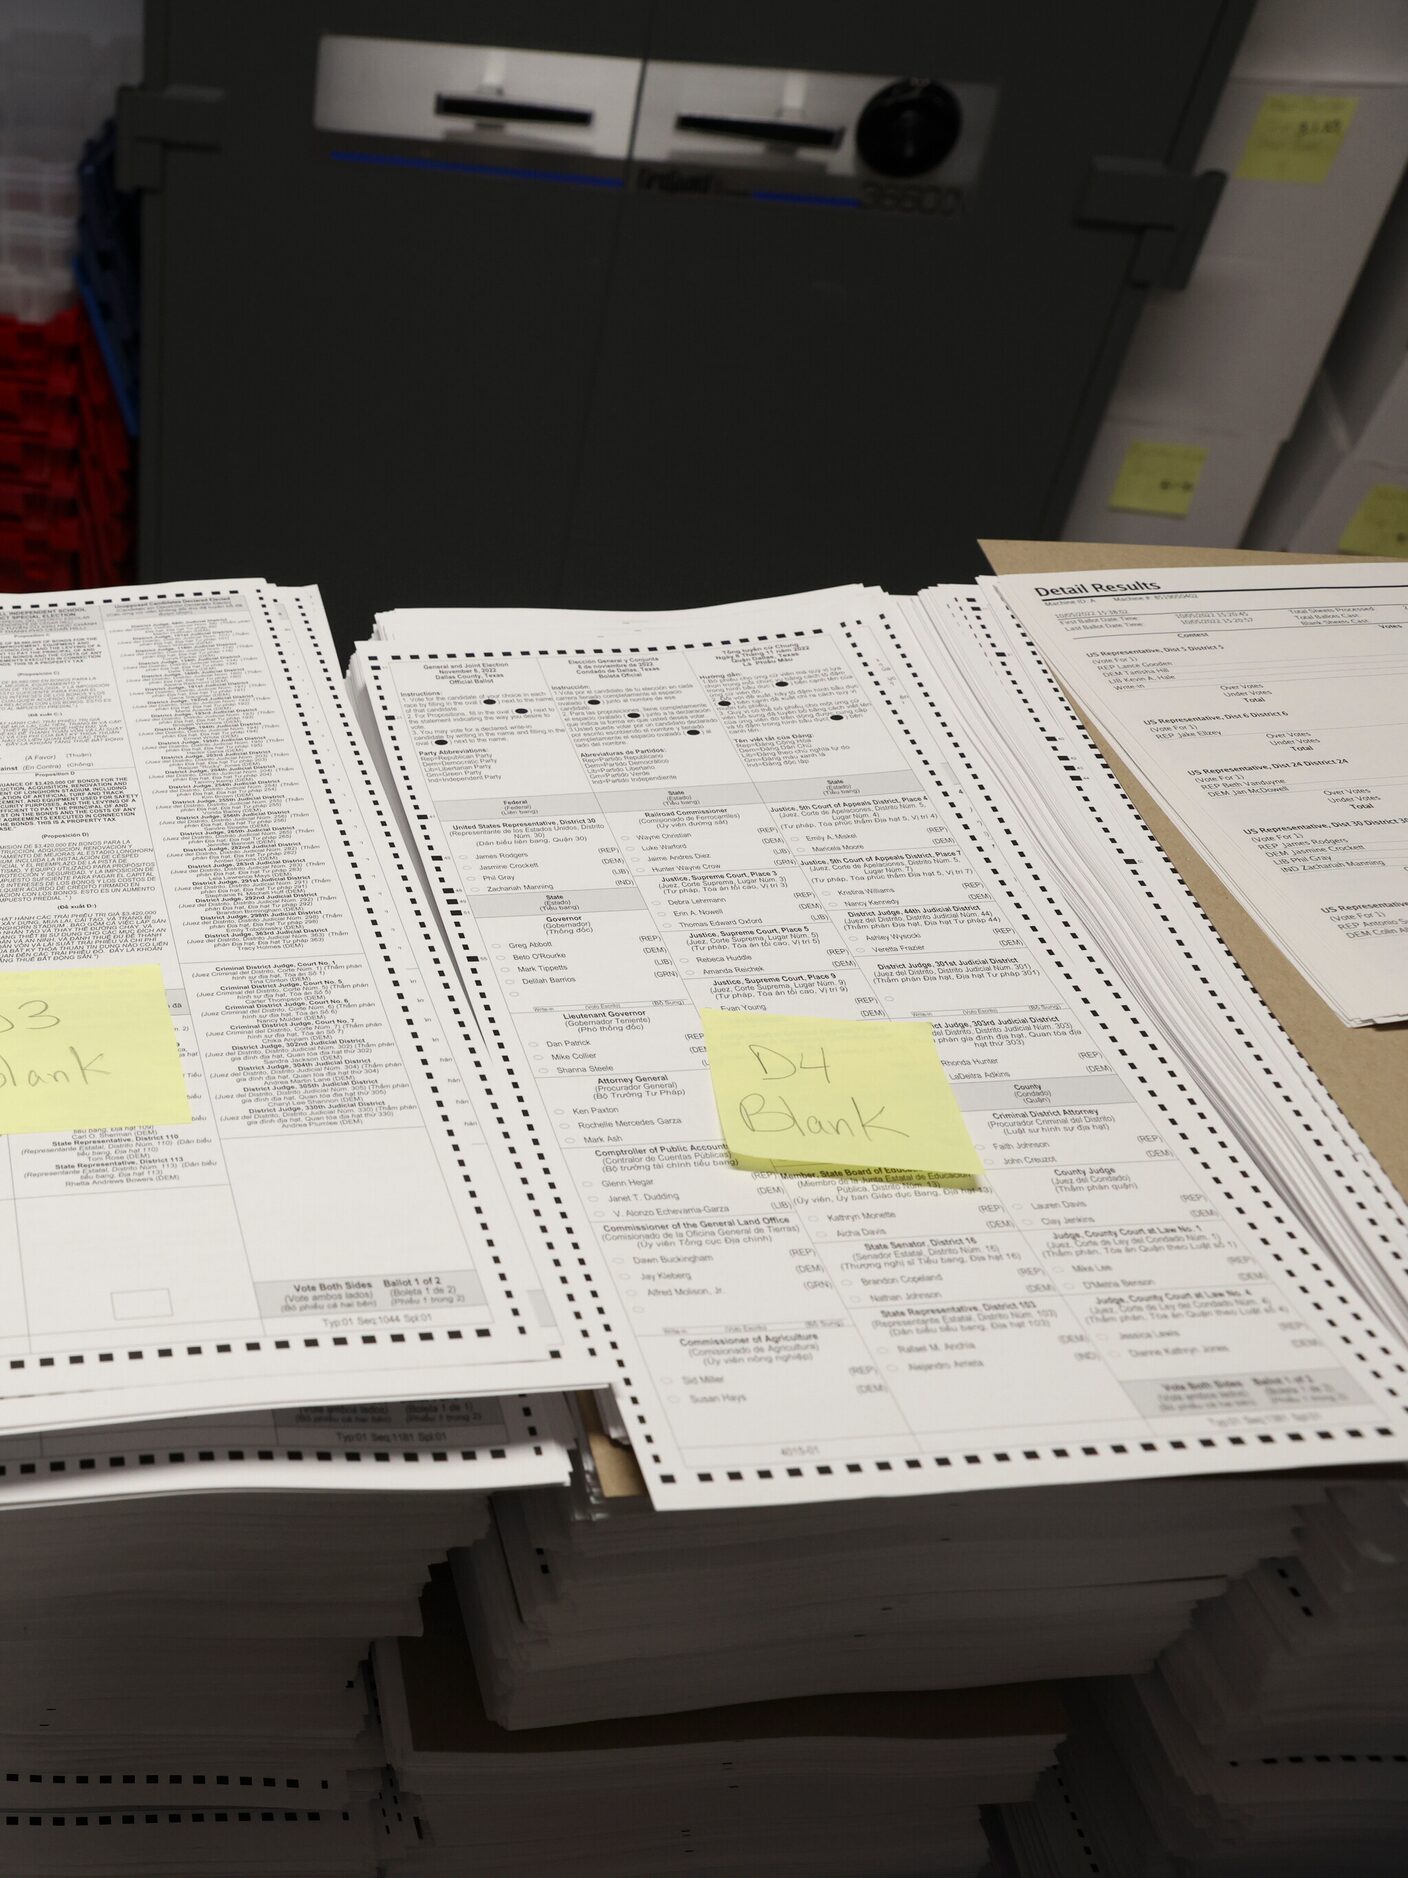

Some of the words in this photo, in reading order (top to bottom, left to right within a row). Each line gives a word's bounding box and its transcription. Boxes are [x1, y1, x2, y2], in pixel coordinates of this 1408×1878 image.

[1035, 584, 1089, 598] Detail
[1091, 581, 1161, 594] Results
[1157, 715, 1225, 725] Representative,
[1155, 732, 1175, 740] REP
[1177, 731, 1197, 739] Jake
[1202, 765, 1269, 777] Representative,
[1302, 759, 1337, 767] District
[1200, 783, 1221, 791] REP
[1221, 781, 1243, 789] Beth
[1242, 779, 1286, 787] Vanduyne
[1207, 790, 1231, 798] DEM
[1247, 785, 1290, 794] McDowell
[644, 810, 676, 818] Railroad
[675, 808, 729, 817] Commissioner
[501, 820, 557, 830] Representative,
[559, 818, 587, 828] District
[1280, 865, 1300, 873] IND
[1300, 862, 1346, 871] Zachariah
[545, 915, 584, 925] Governor
[508, 942, 528, 950] Greg
[531, 952, 567, 960] O'Rourke
[562, 1011, 607, 1020] Lieutenant
[607, 1010, 646, 1019] Governor
[545, 1040, 563, 1048] Dan
[563, 1039, 592, 1047] Patrick
[748, 1044, 831, 1083] D4
[597, 1077, 634, 1085] Attorney
[634, 1074, 669, 1083] General
[572, 1107, 590, 1115] Ken
[590, 1106, 620, 1114] Paxton
[738, 1093, 909, 1139] Blank
[992, 1111, 1029, 1120] Criminal
[1028, 1109, 1062, 1118] District
[1062, 1109, 1099, 1117] Attorney
[1053, 1168, 1087, 1177] County
[1088, 1167, 1116, 1176] Judge
[293, 1284, 317, 1293] Vote
[318, 1282, 343, 1292] Both
[344, 1281, 373, 1290] Sides
[382, 1278, 413, 1288] Ballot
[422, 1276, 433, 1286] of
